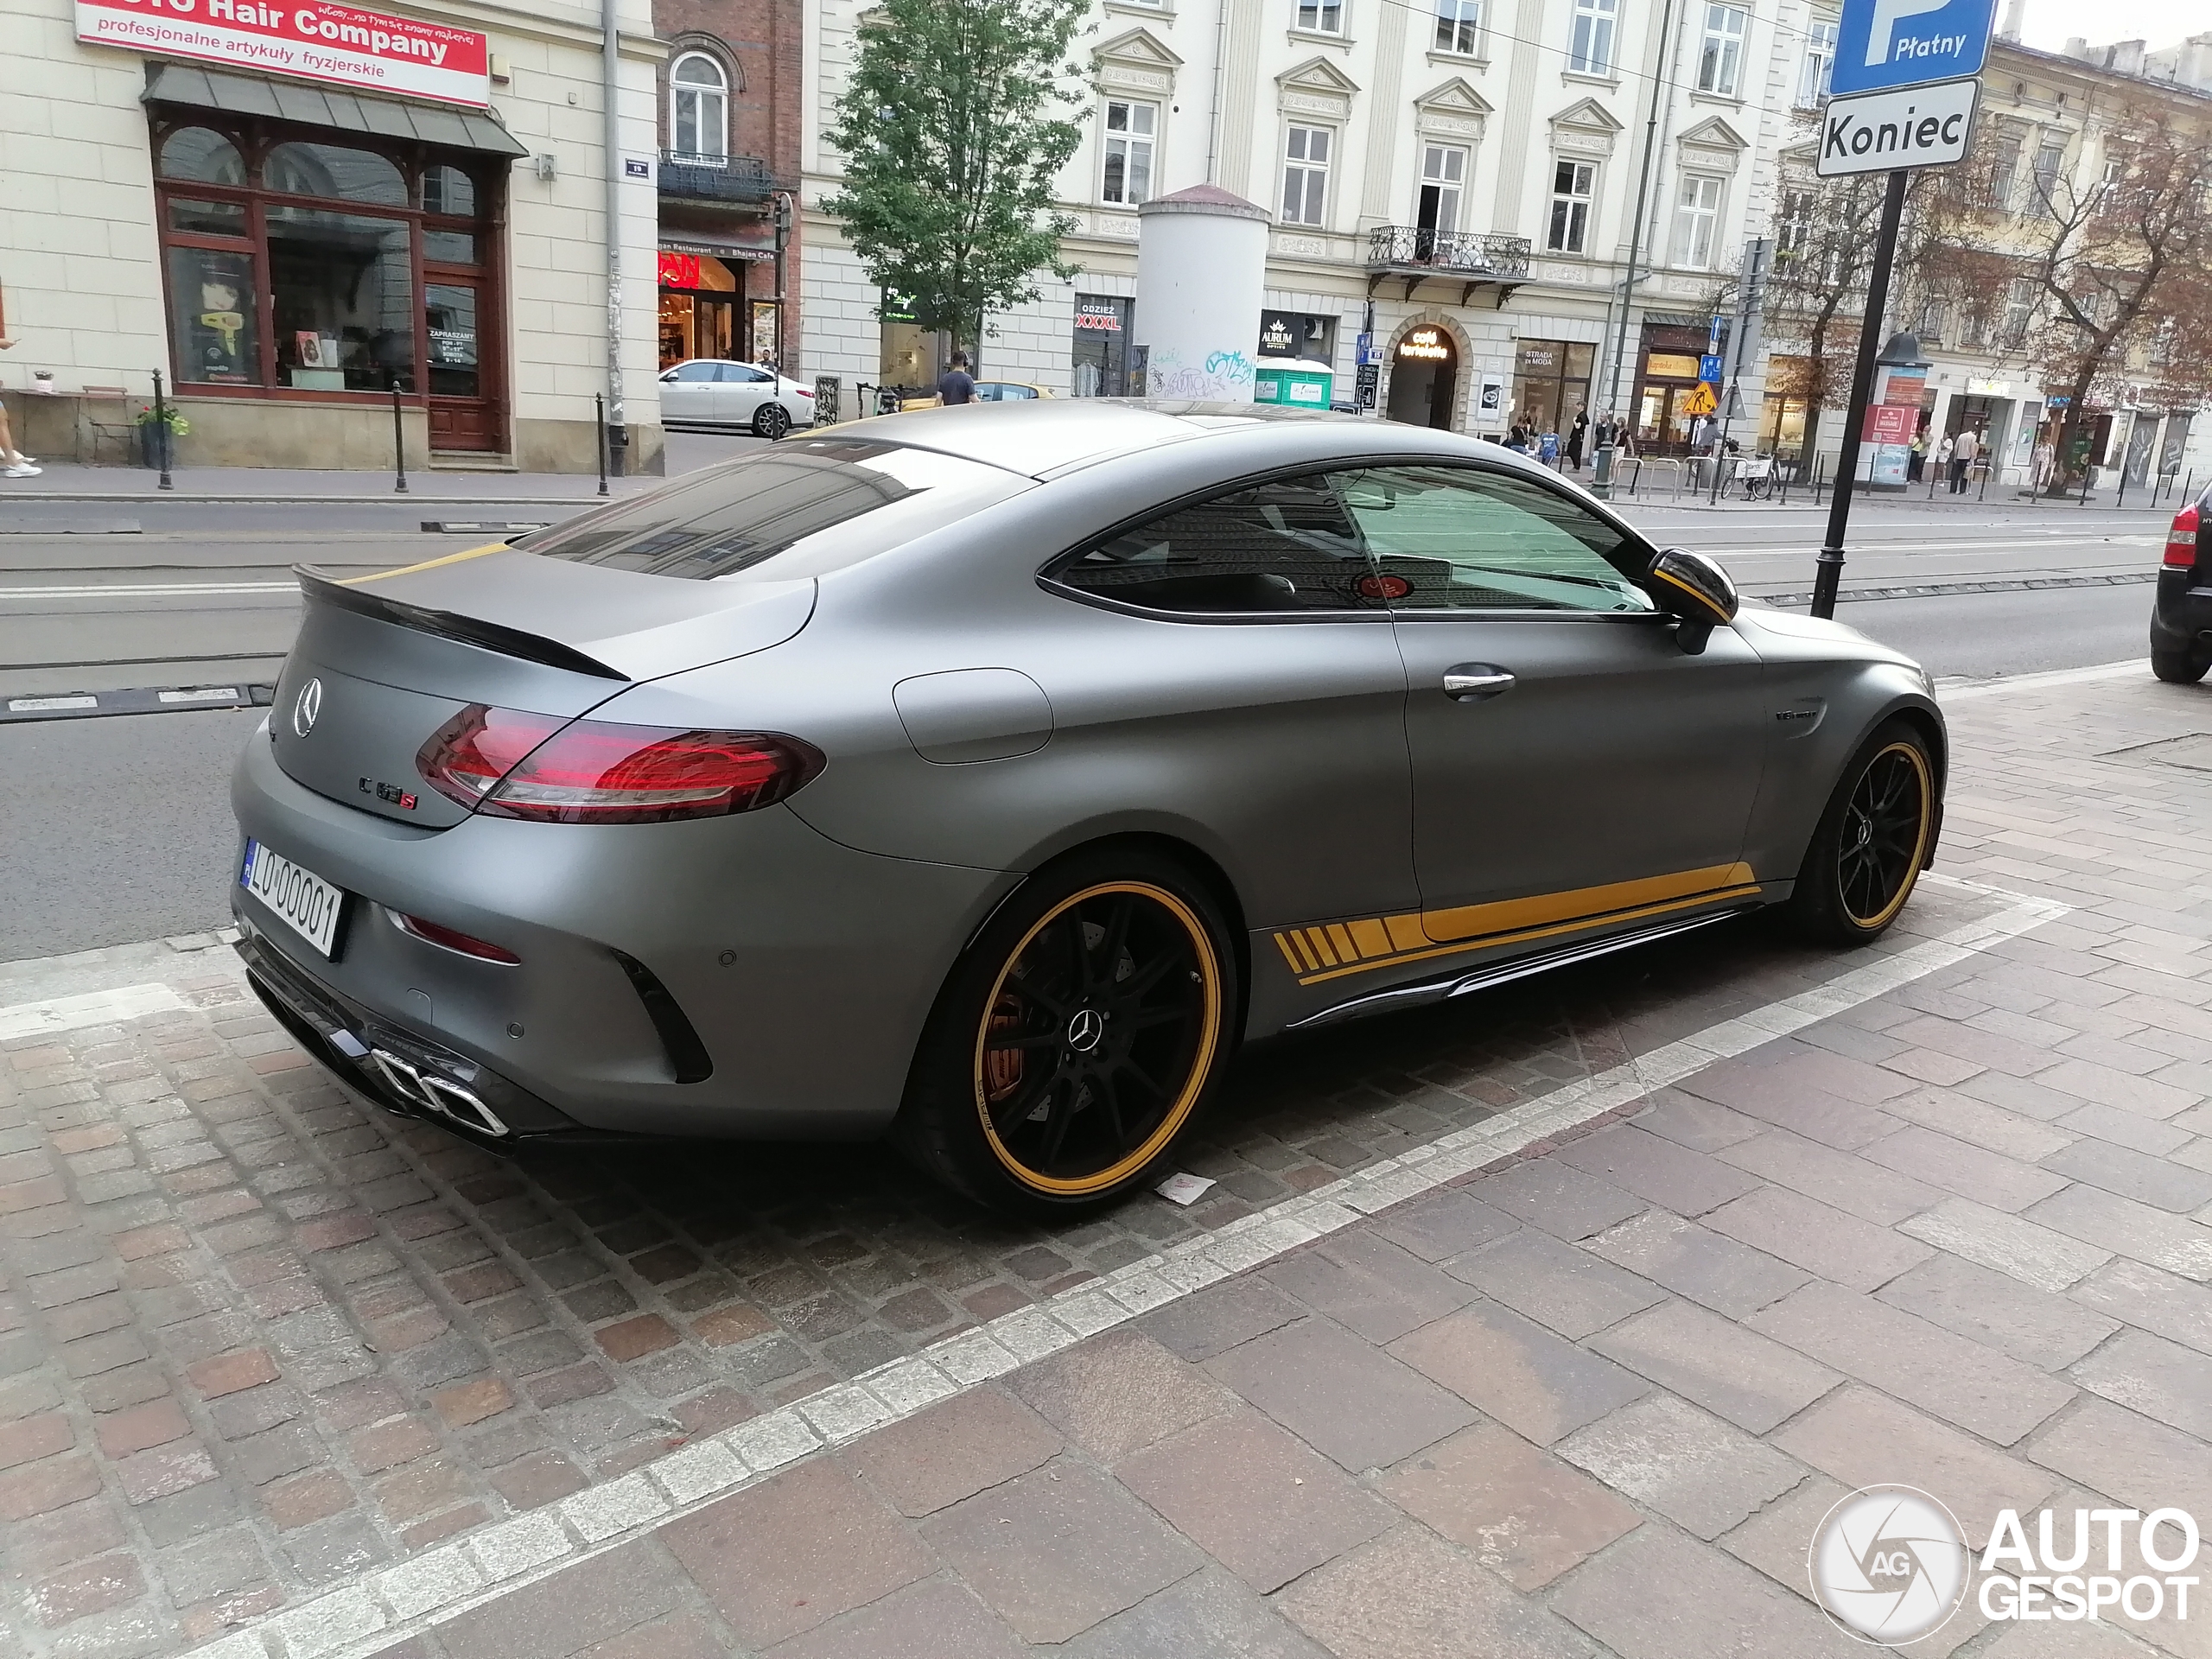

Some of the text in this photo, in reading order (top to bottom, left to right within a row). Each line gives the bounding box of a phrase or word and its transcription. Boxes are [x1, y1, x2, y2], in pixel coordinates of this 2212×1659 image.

[209, 0, 448, 65] Hair Company
[98, 18, 385, 77] profesjonalne artykuły fryzjerskie
[1895, 33, 1967, 61] Płatny
[1825, 105, 1963, 159] Koniec
[673, 244, 712, 254] Restaurant
[732, 249, 757, 258] Bhajan
[1082, 304, 1115, 315] ODZIEŻ
[1075, 314, 1121, 331] XXXL
[1262, 332, 1293, 344] AURUM
[1526, 351, 1553, 359] STRADA
